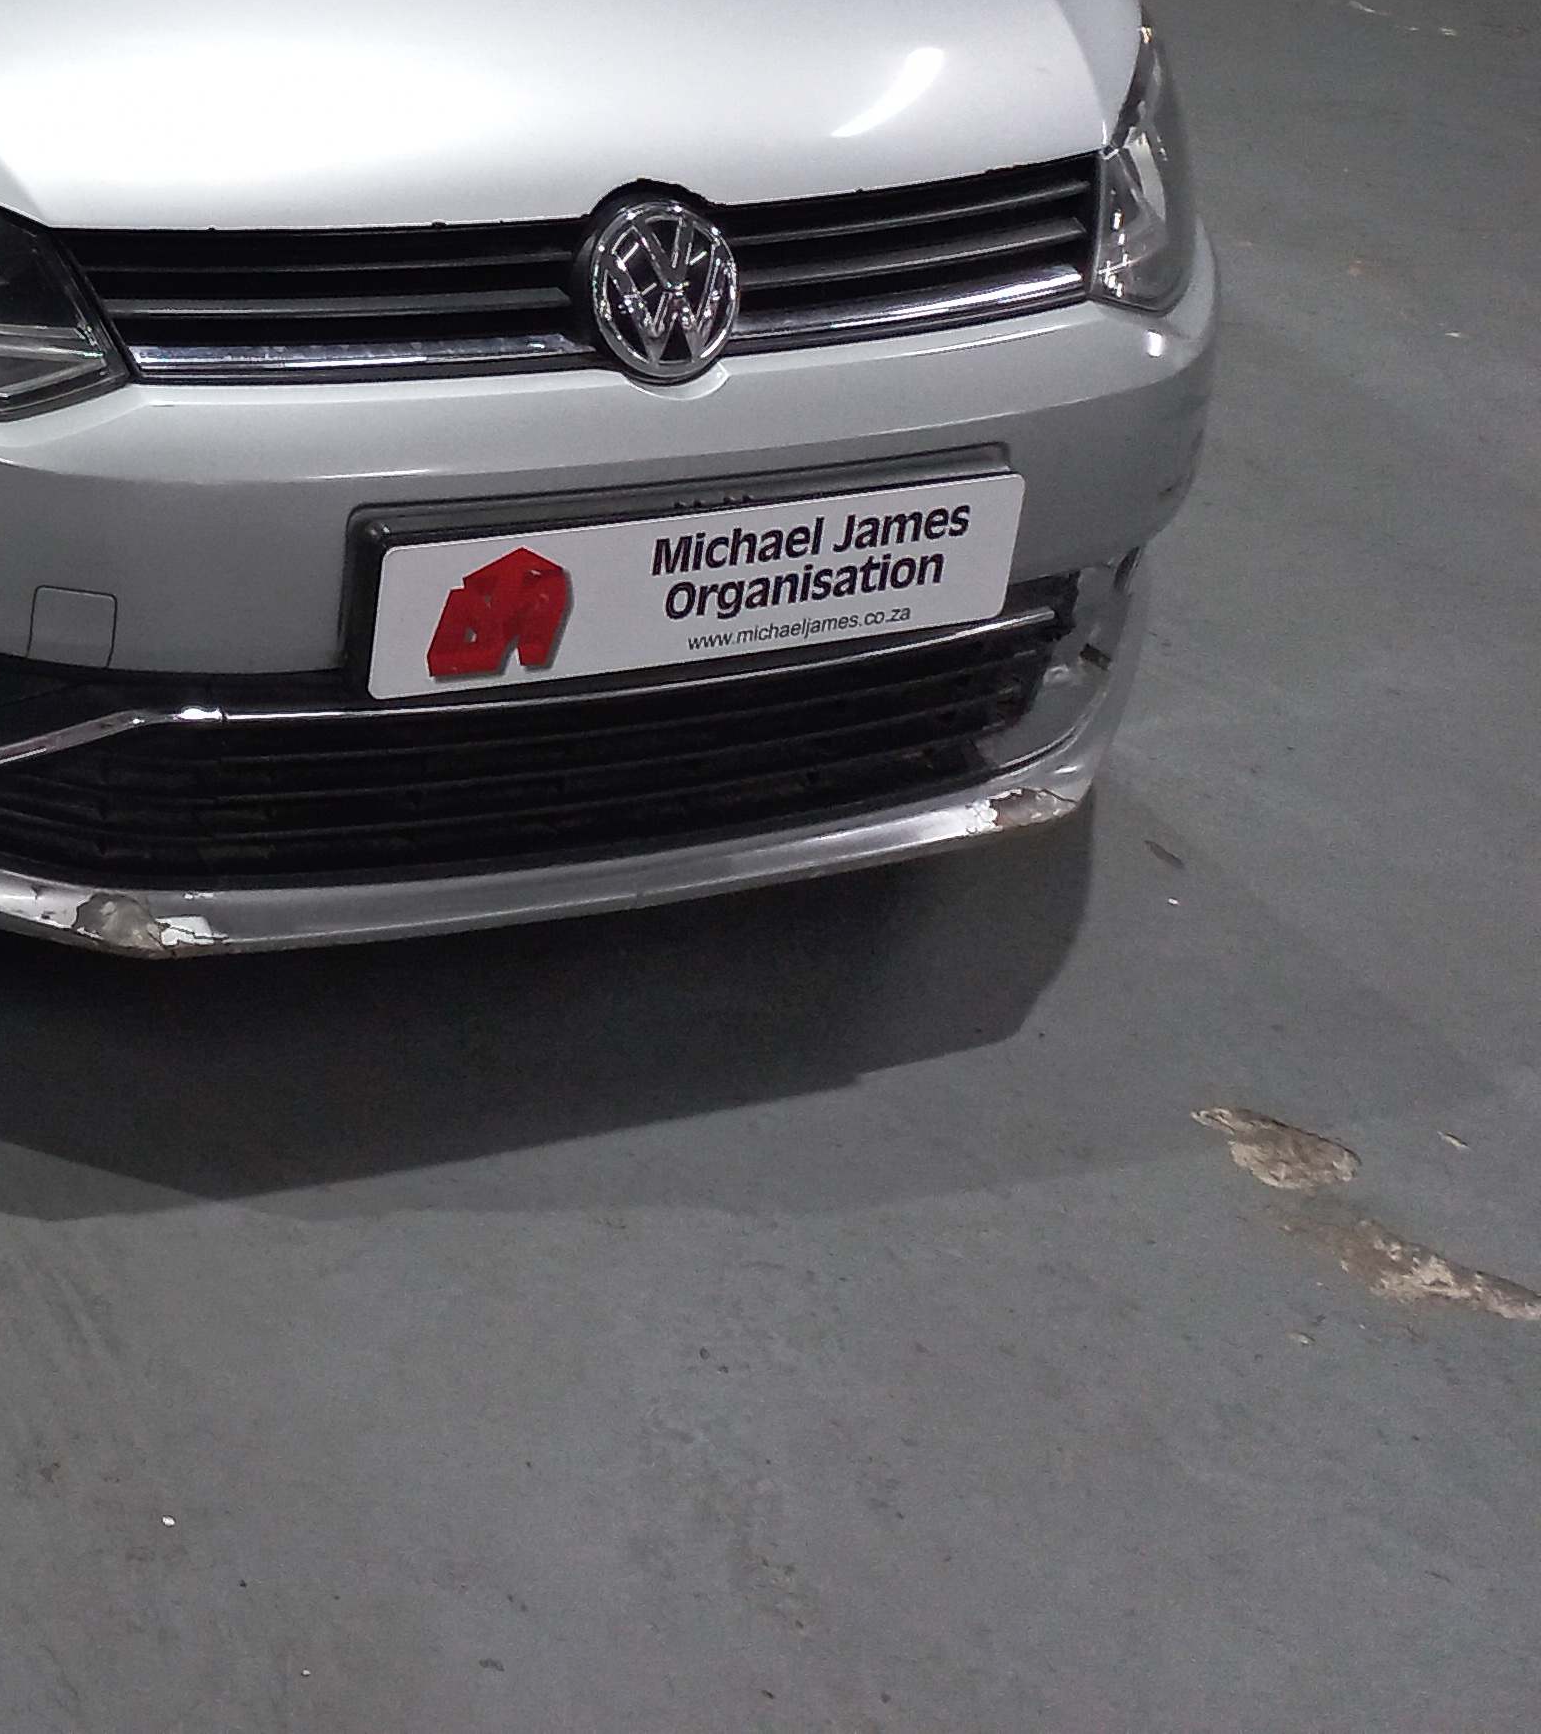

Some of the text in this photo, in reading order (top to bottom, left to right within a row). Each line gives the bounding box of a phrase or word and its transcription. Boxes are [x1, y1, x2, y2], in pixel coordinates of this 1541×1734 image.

[651, 504, 971, 577] Michael James
[665, 552, 944, 620] Organisation
[687, 606, 912, 650] www.michaeljames.co.za
